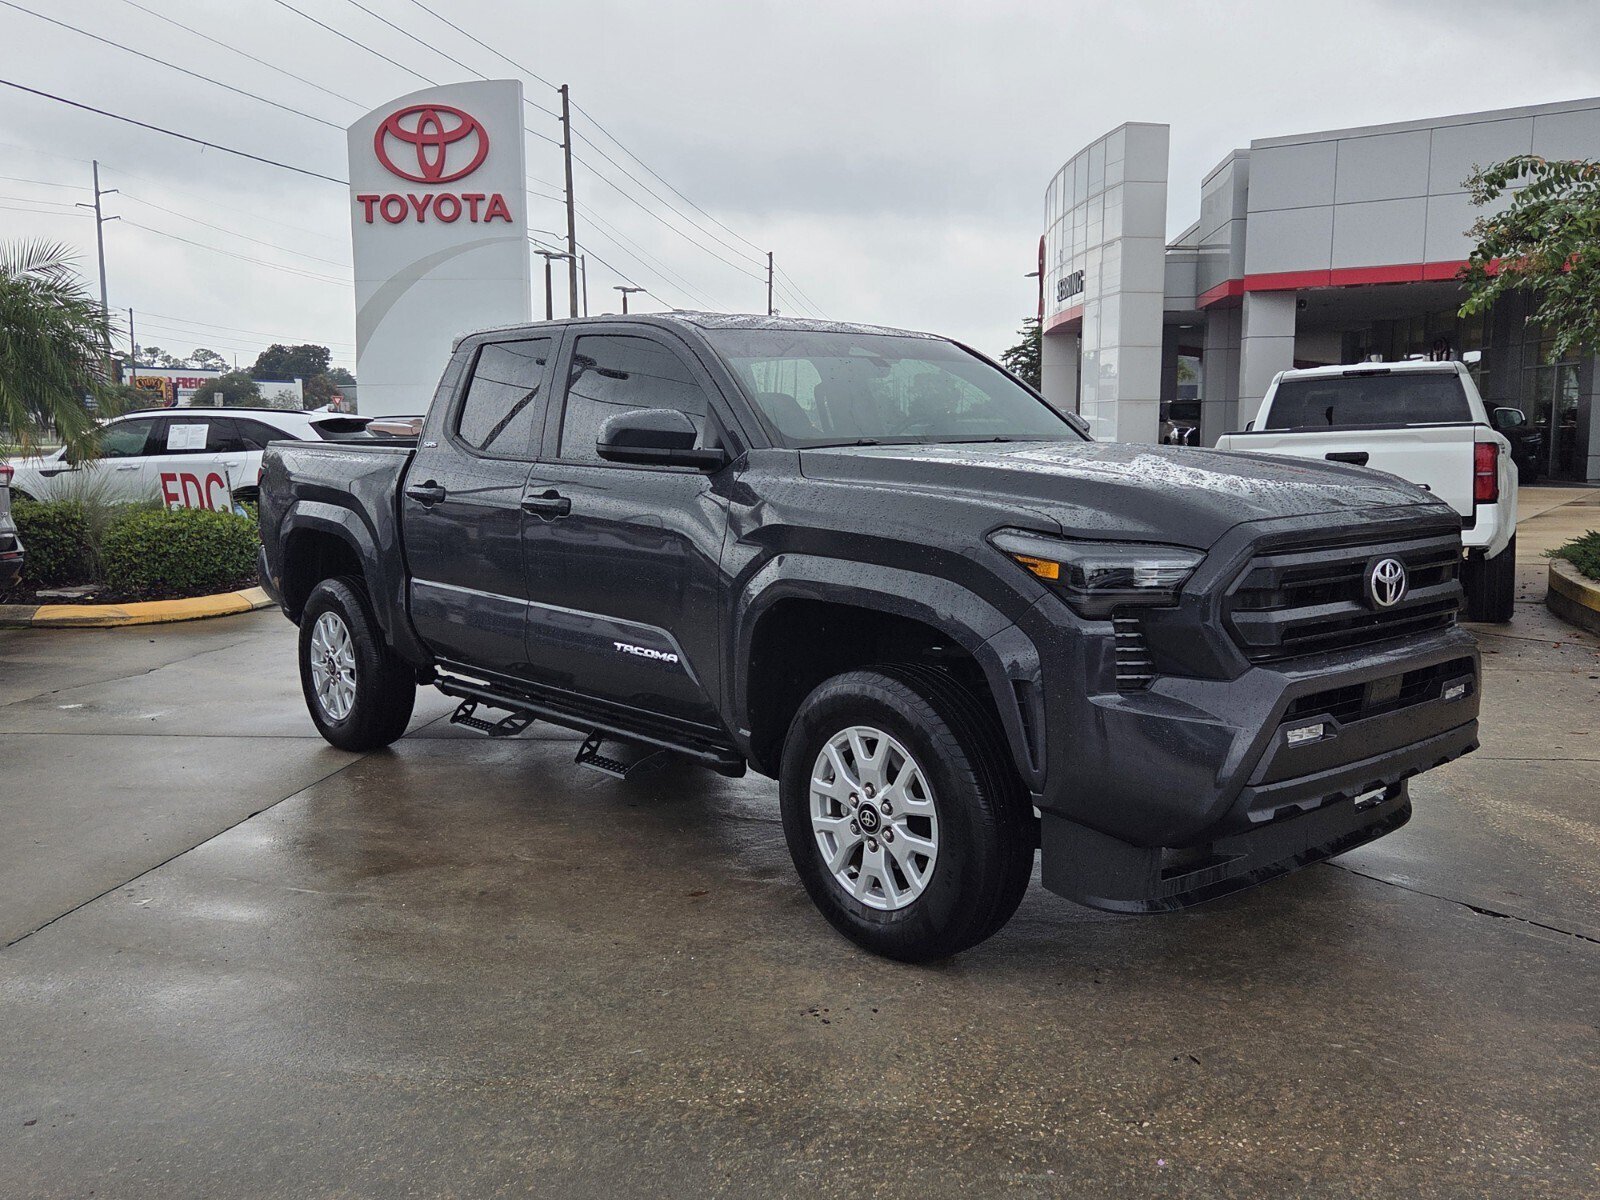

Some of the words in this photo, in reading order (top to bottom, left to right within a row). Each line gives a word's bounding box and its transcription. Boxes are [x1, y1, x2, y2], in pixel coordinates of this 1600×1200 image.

[357, 193, 513, 224] TOYOTA
[175, 377, 209, 389] FREIG
[613, 642, 679, 663] TACOMA
